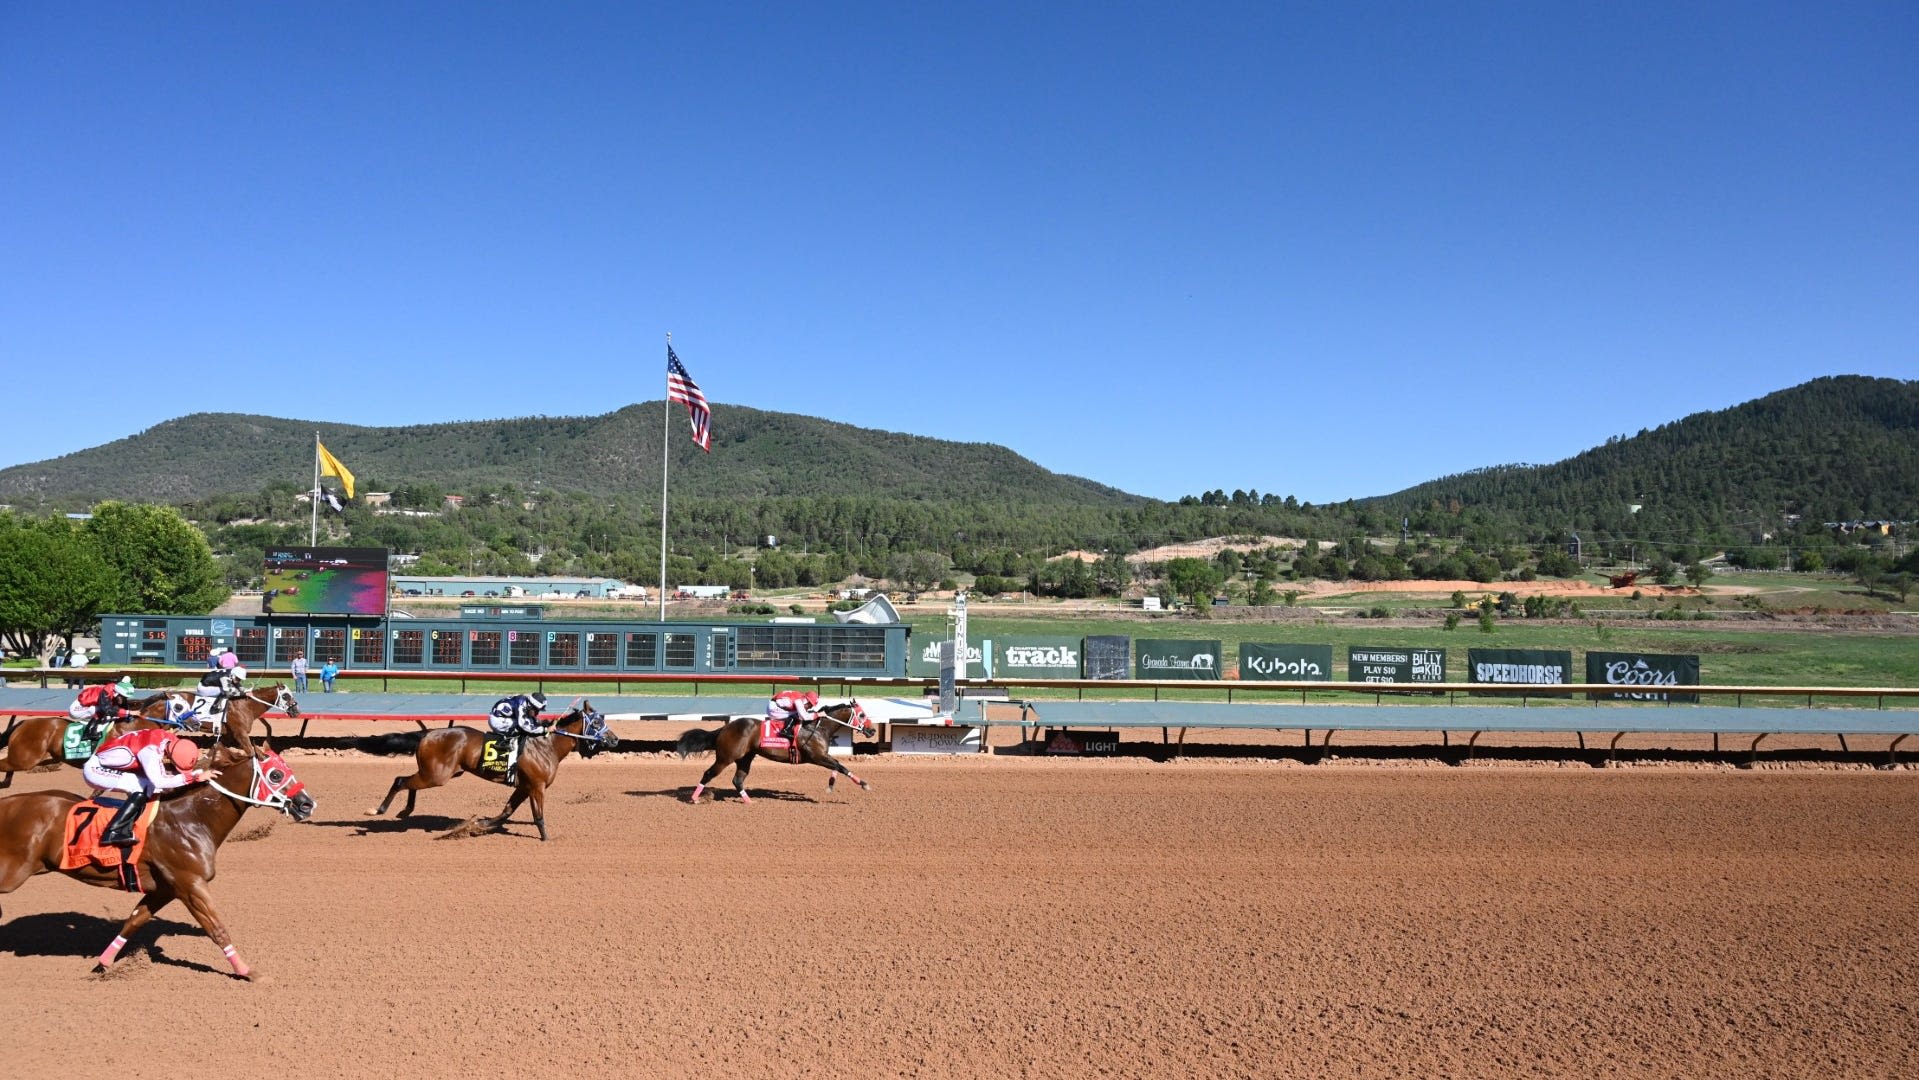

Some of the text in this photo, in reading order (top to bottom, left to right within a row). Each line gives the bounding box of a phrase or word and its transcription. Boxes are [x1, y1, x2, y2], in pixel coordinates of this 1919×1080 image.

[274, 629, 281, 638] 2
[313, 629, 320, 639] 3
[353, 630, 360, 638] 4
[392, 630, 398, 639] 5
[431, 630, 438, 640] 6
[471, 632, 476, 640] 7
[509, 632, 516, 641] 8
[548, 633, 555, 641] 9
[1005, 646, 1078, 665] track
[1352, 653, 1408, 663] NEW MEMBERS!
[1412, 653, 1442, 666] BILLY
[1247, 656, 1323, 676] Kubota
[1363, 665, 1396, 675] PLAY $10
[1424, 665, 1442, 676] KID
[1477, 662, 1562, 684] SPEEDHORSE
[1605, 661, 1678, 685] Coors
[764, 720, 771, 738] 1
[66, 725, 84, 748] 5
[483, 740, 498, 761] 6
[1085, 741, 1117, 752] LIGHT
[68, 806, 100, 847] 7
